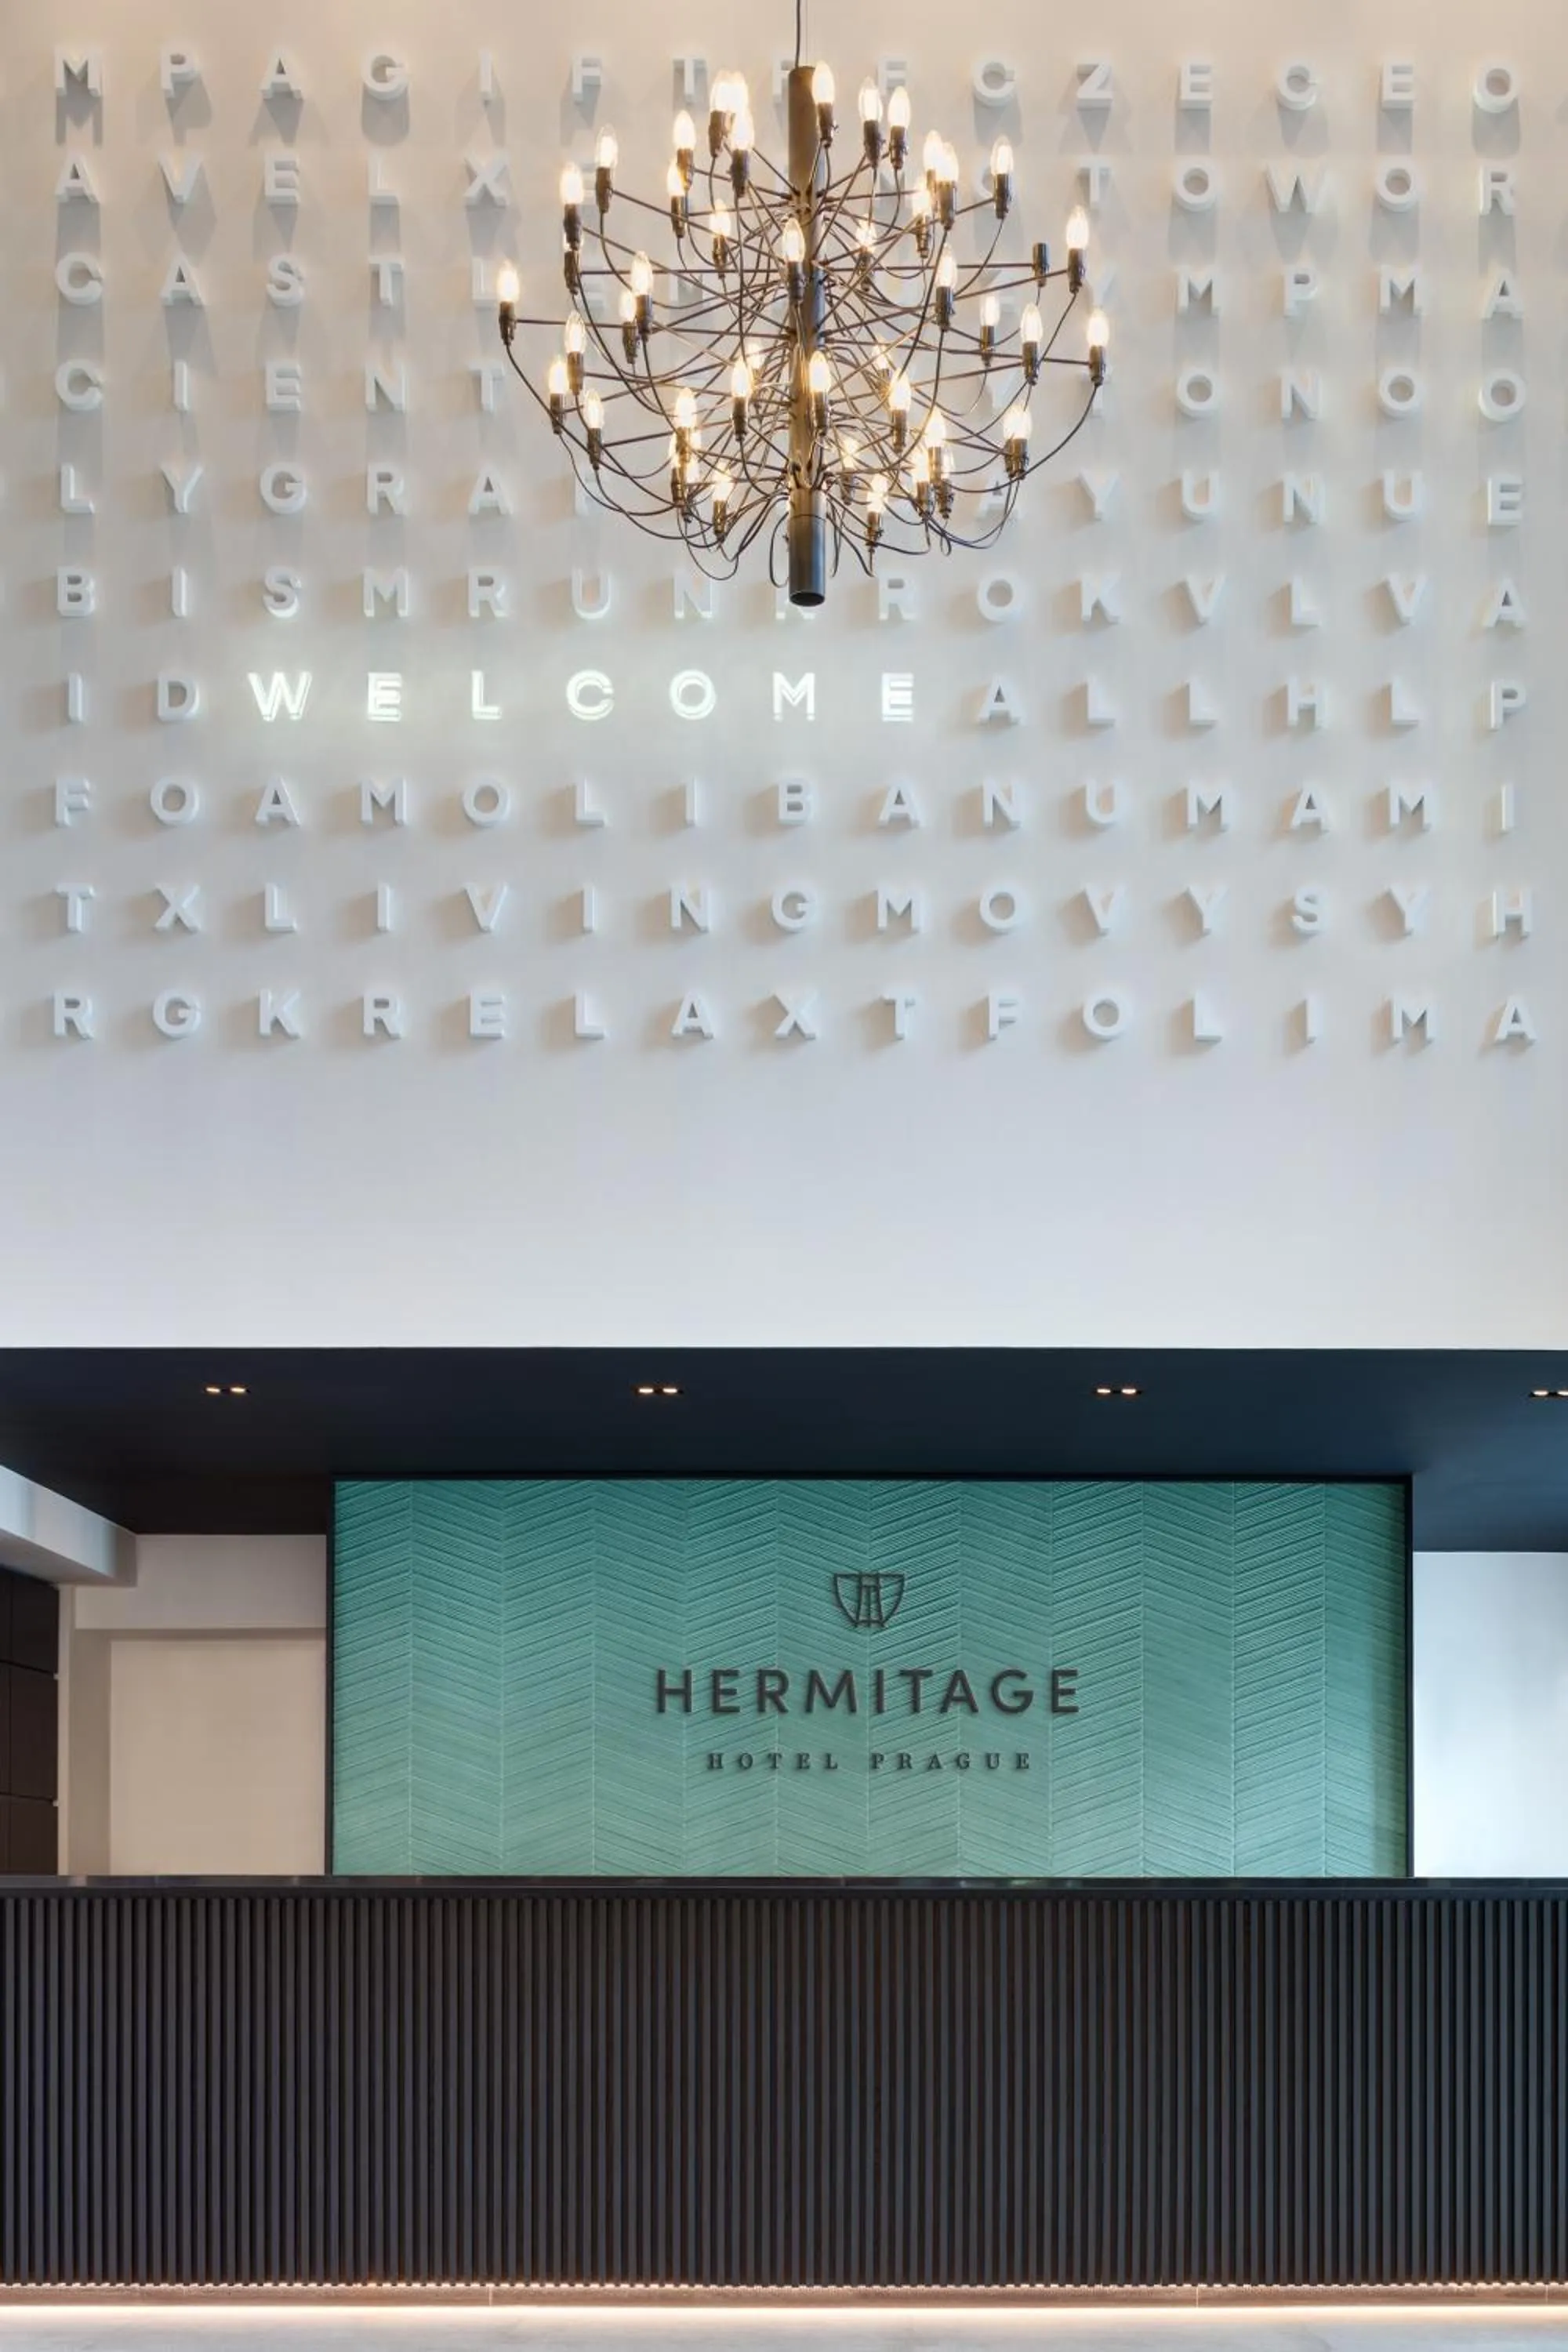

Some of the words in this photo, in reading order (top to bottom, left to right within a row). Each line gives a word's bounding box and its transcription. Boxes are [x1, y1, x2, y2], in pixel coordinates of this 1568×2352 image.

[248, 670, 914, 722] WELCOME
[655, 1668, 1080, 1714] HERMITAGE
[707, 1751, 838, 1770] HOTEL
[871, 1751, 1031, 1770] PRAGUE
